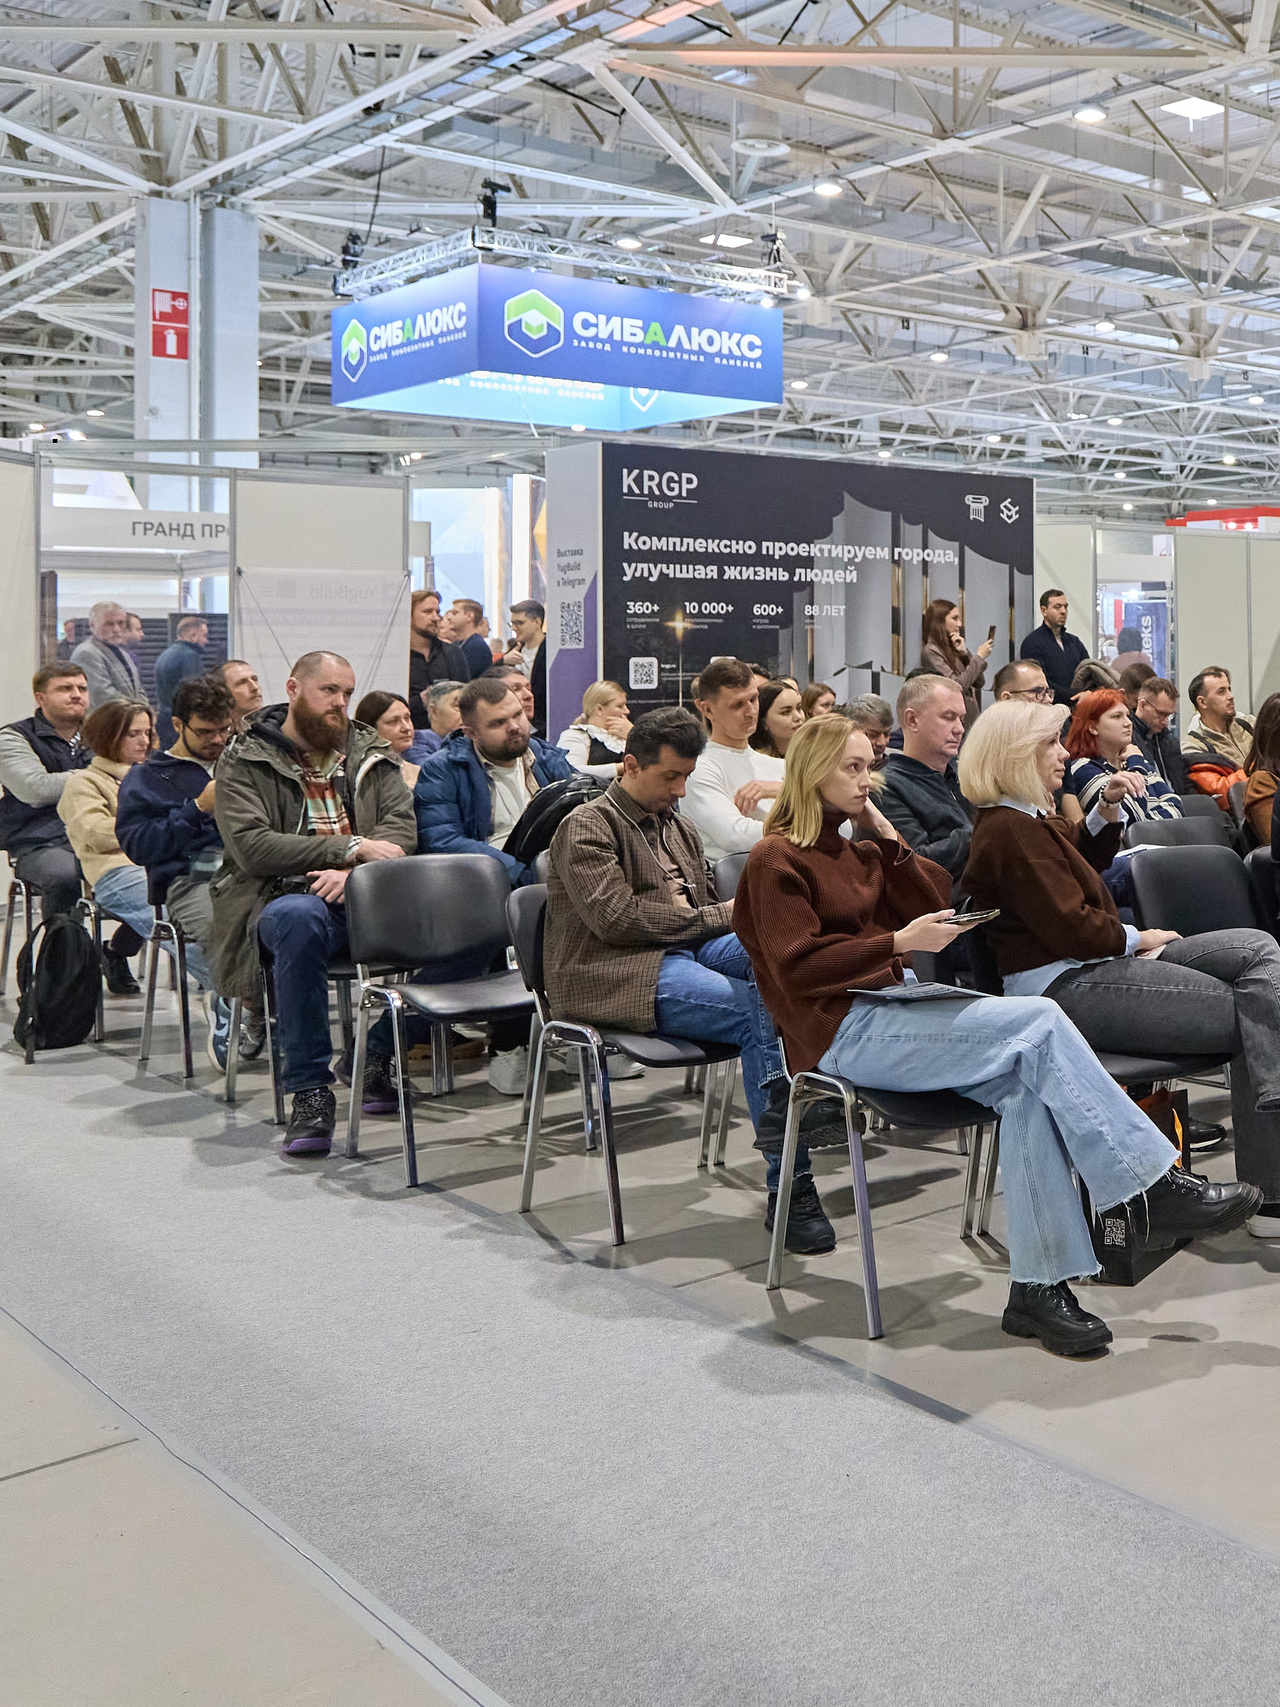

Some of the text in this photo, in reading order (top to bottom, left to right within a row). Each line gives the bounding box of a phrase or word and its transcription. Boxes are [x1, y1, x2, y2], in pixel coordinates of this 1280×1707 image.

[369, 302, 467, 352] СИБАЛЮКС
[572, 311, 762, 359] СИБАЛЮКС
[573, 339, 762, 369] ЗАВОД КОМПОЗИТНЫХ ПАНЕЛЕЙ
[622, 468, 699, 497] KRGP
[648, 501, 675, 509] GROUP
[132, 521, 229, 540] ГРАНД ПР
[623, 532, 959, 565] Комплексно проектируем города,
[622, 562, 857, 584] улучшая жизнь людей
[626, 601, 660, 614] 360+
[684, 602, 734, 615] 10 000+
[753, 604, 784, 616] 600+
[804, 605, 846, 617] 88 ЛЕТ
[1141, 615, 1153, 662] teks
